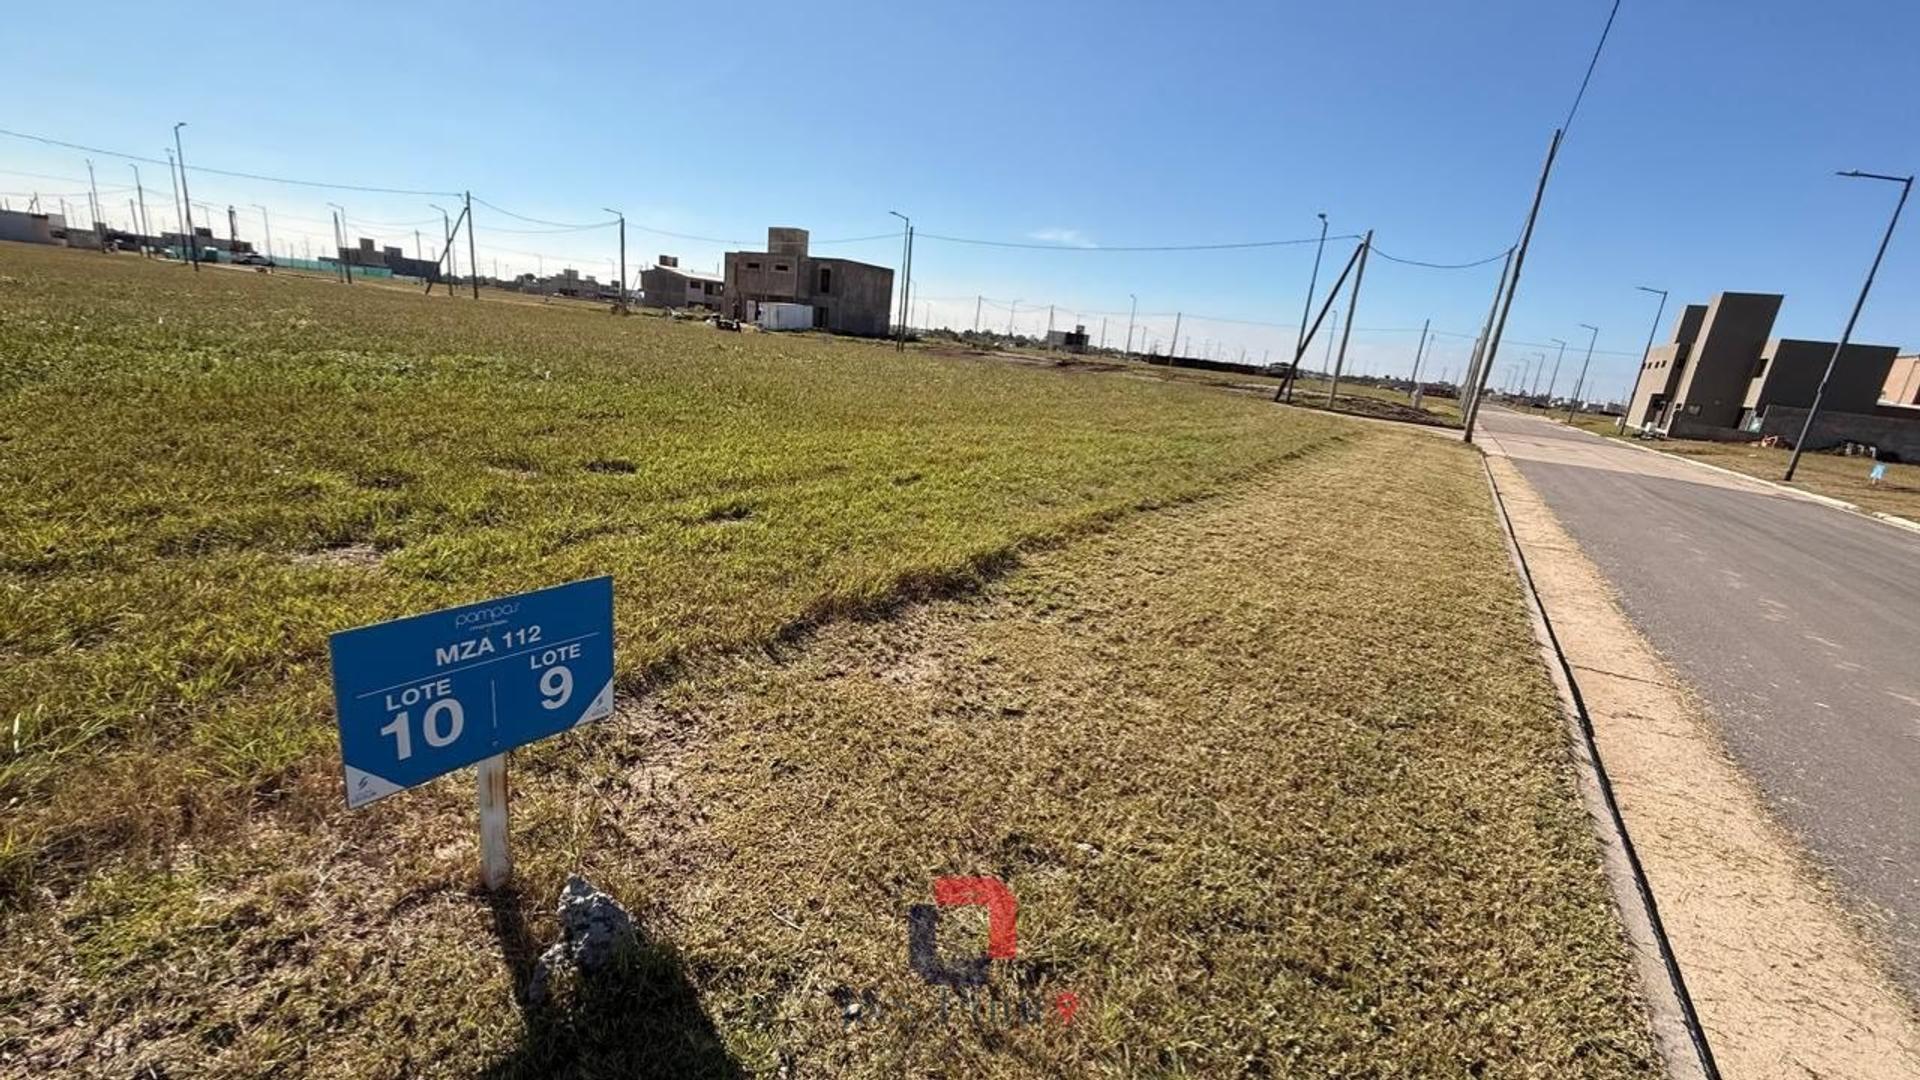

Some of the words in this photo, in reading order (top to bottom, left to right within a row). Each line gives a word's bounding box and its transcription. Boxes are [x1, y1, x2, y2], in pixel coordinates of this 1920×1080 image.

[435, 638, 495, 667] MZA
[501, 625, 542, 649] 112
[530, 643, 581, 670] LOTE
[386, 678, 452, 711] LOTE
[539, 665, 574, 710] 9
[380, 698, 465, 761] 10
